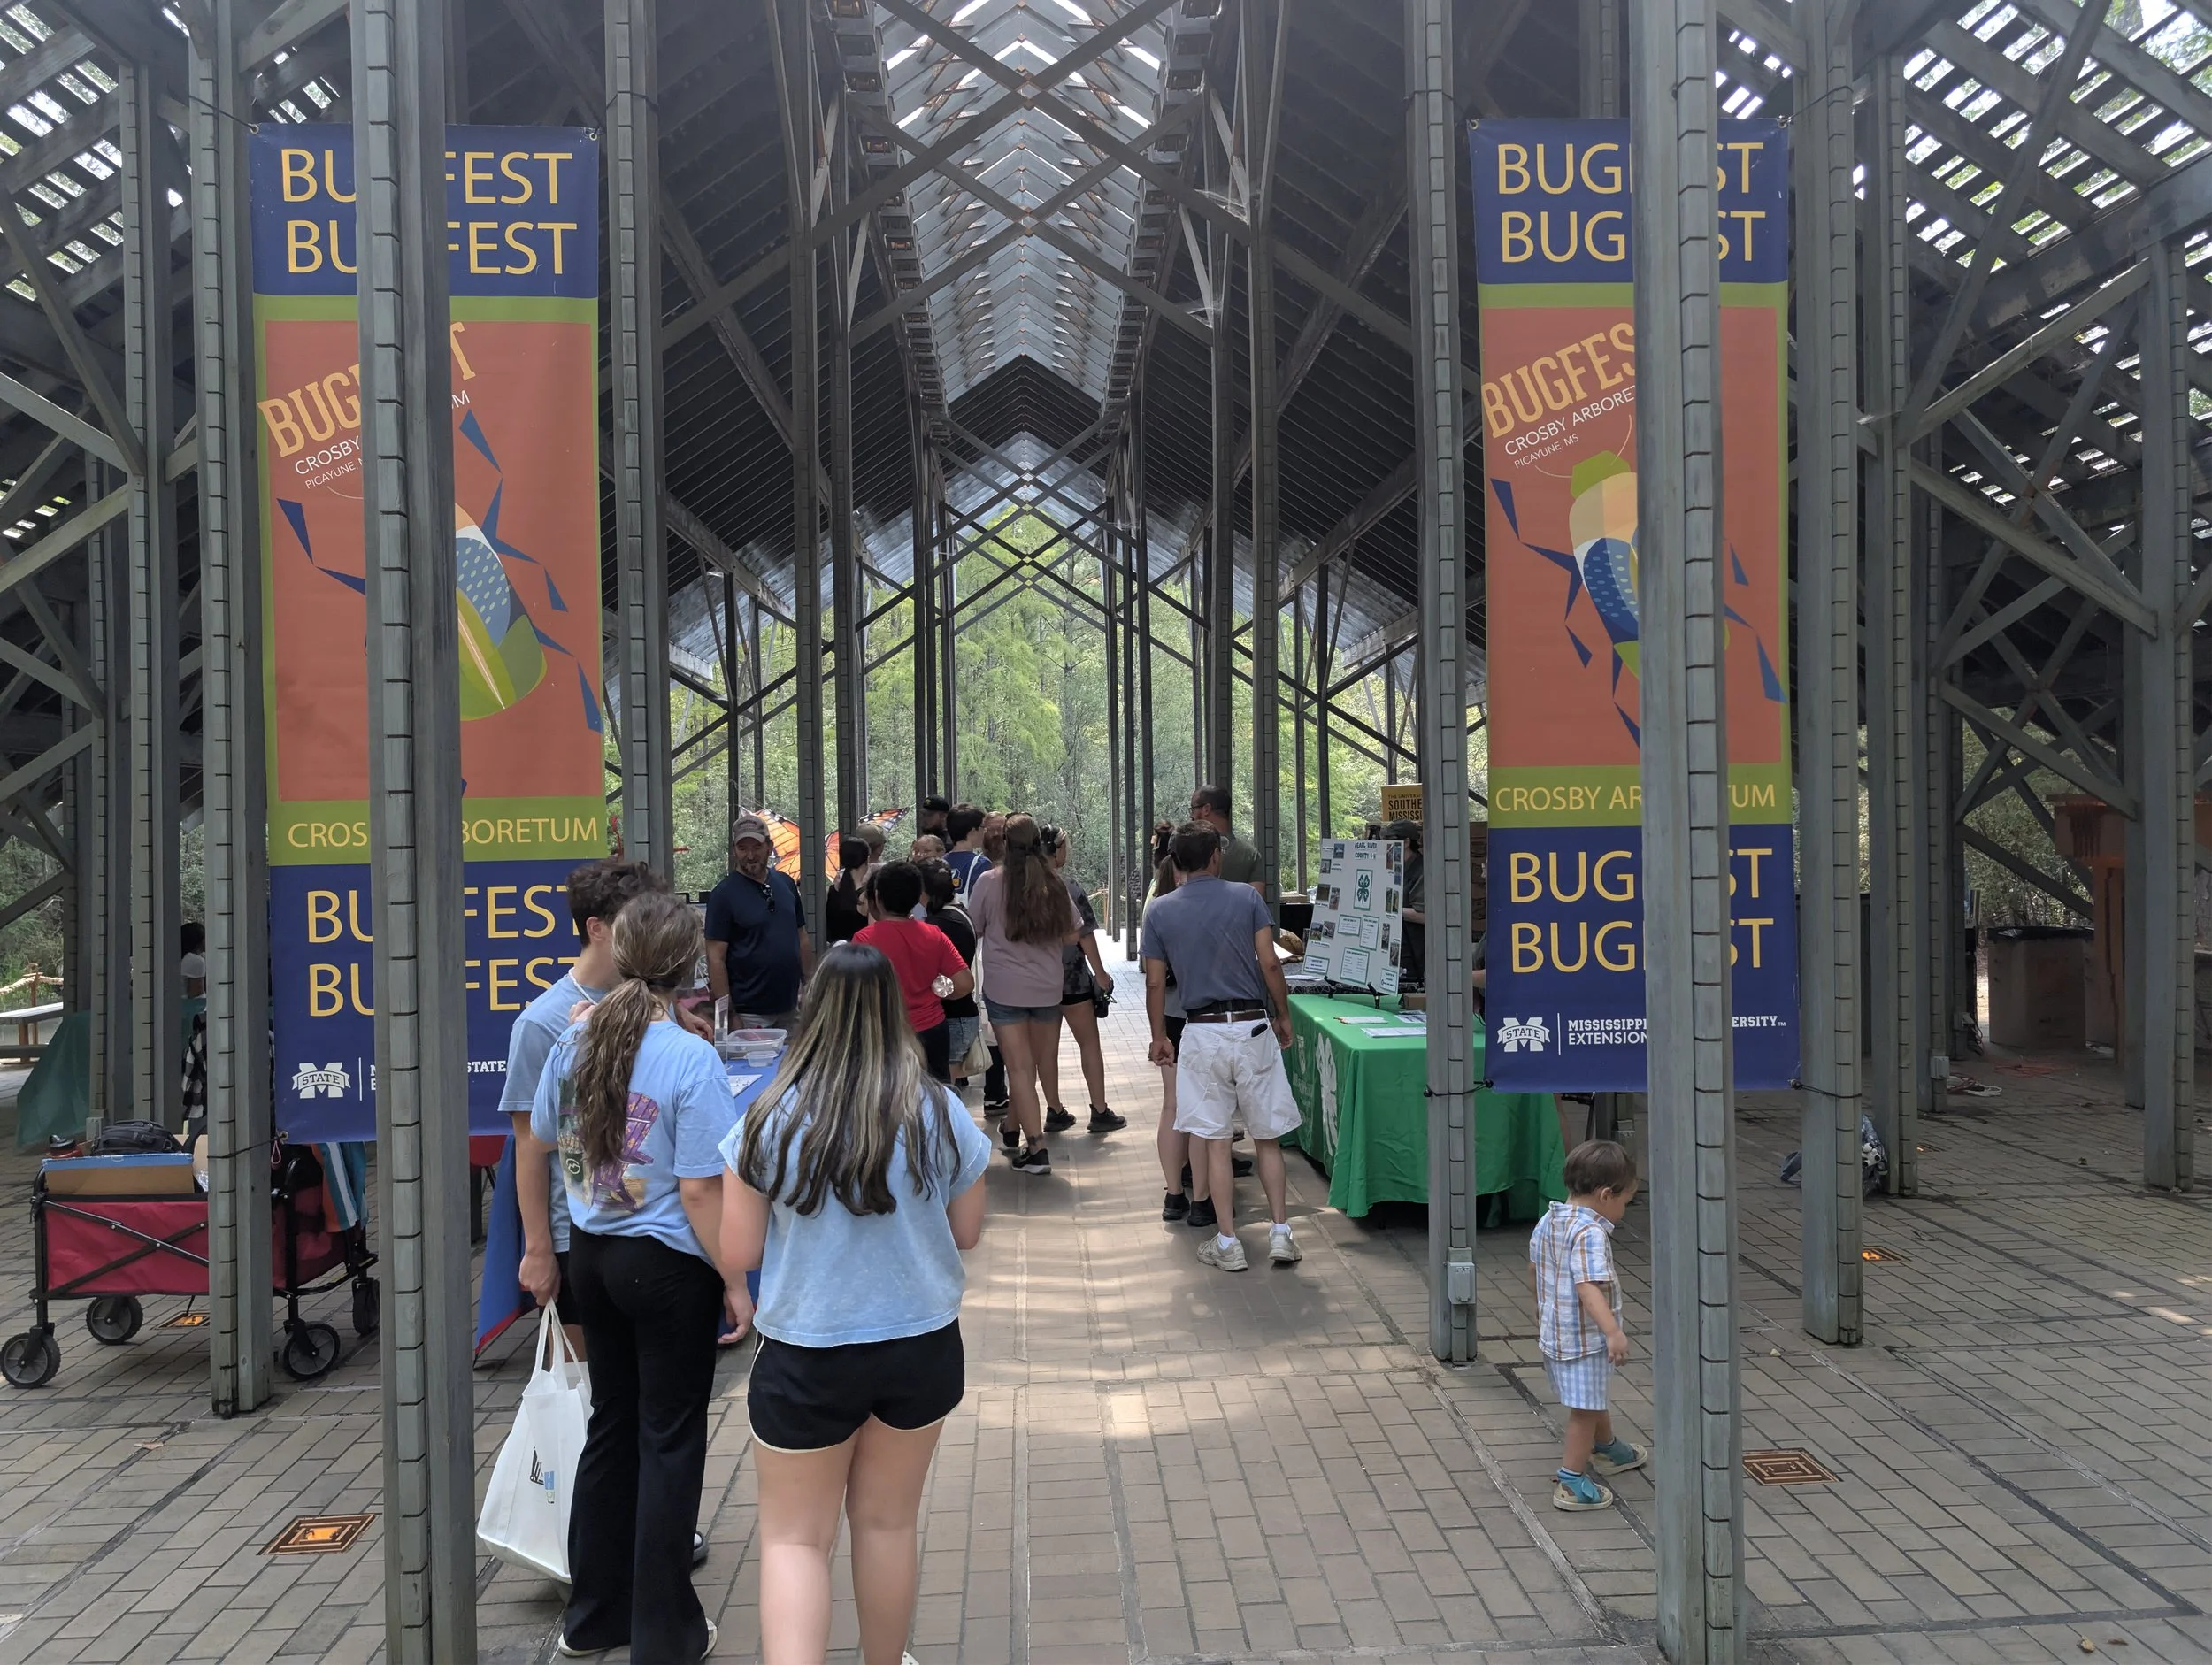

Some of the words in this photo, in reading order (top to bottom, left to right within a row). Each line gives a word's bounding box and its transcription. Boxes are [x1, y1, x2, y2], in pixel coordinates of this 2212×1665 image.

[280, 149, 572, 204] BUEST
[1497, 142, 1764, 195] BUGT
[287, 219, 577, 274] BUEST
[1501, 211, 1766, 263] BUGT
[257, 321, 476, 457] BUGT
[1481, 322, 1635, 439] BUGFES
[1505, 417, 1566, 456] CROSBY
[1571, 385, 1635, 426] ARBORE
[295, 435, 360, 474] CROSBY
[1514, 441, 1564, 469] PICAYUNE,
[1564, 433, 1579, 447] MS
[304, 461, 358, 489] PICAYUNE,
[1388, 798, 1423, 811] SOUTHE
[1389, 810, 1423, 821] MISSISSI
[1495, 786, 1601, 811] CROSBY
[288, 821, 368, 848] CROS
[462, 817, 598, 845] BORETUM
[1509, 848, 1772, 903] BUGT
[307, 885, 580, 944] BUES
[1511, 917, 1774, 973] BUGT
[1506, 1027, 1541, 1040] STATE
[302, 1073, 341, 1086] STATE
